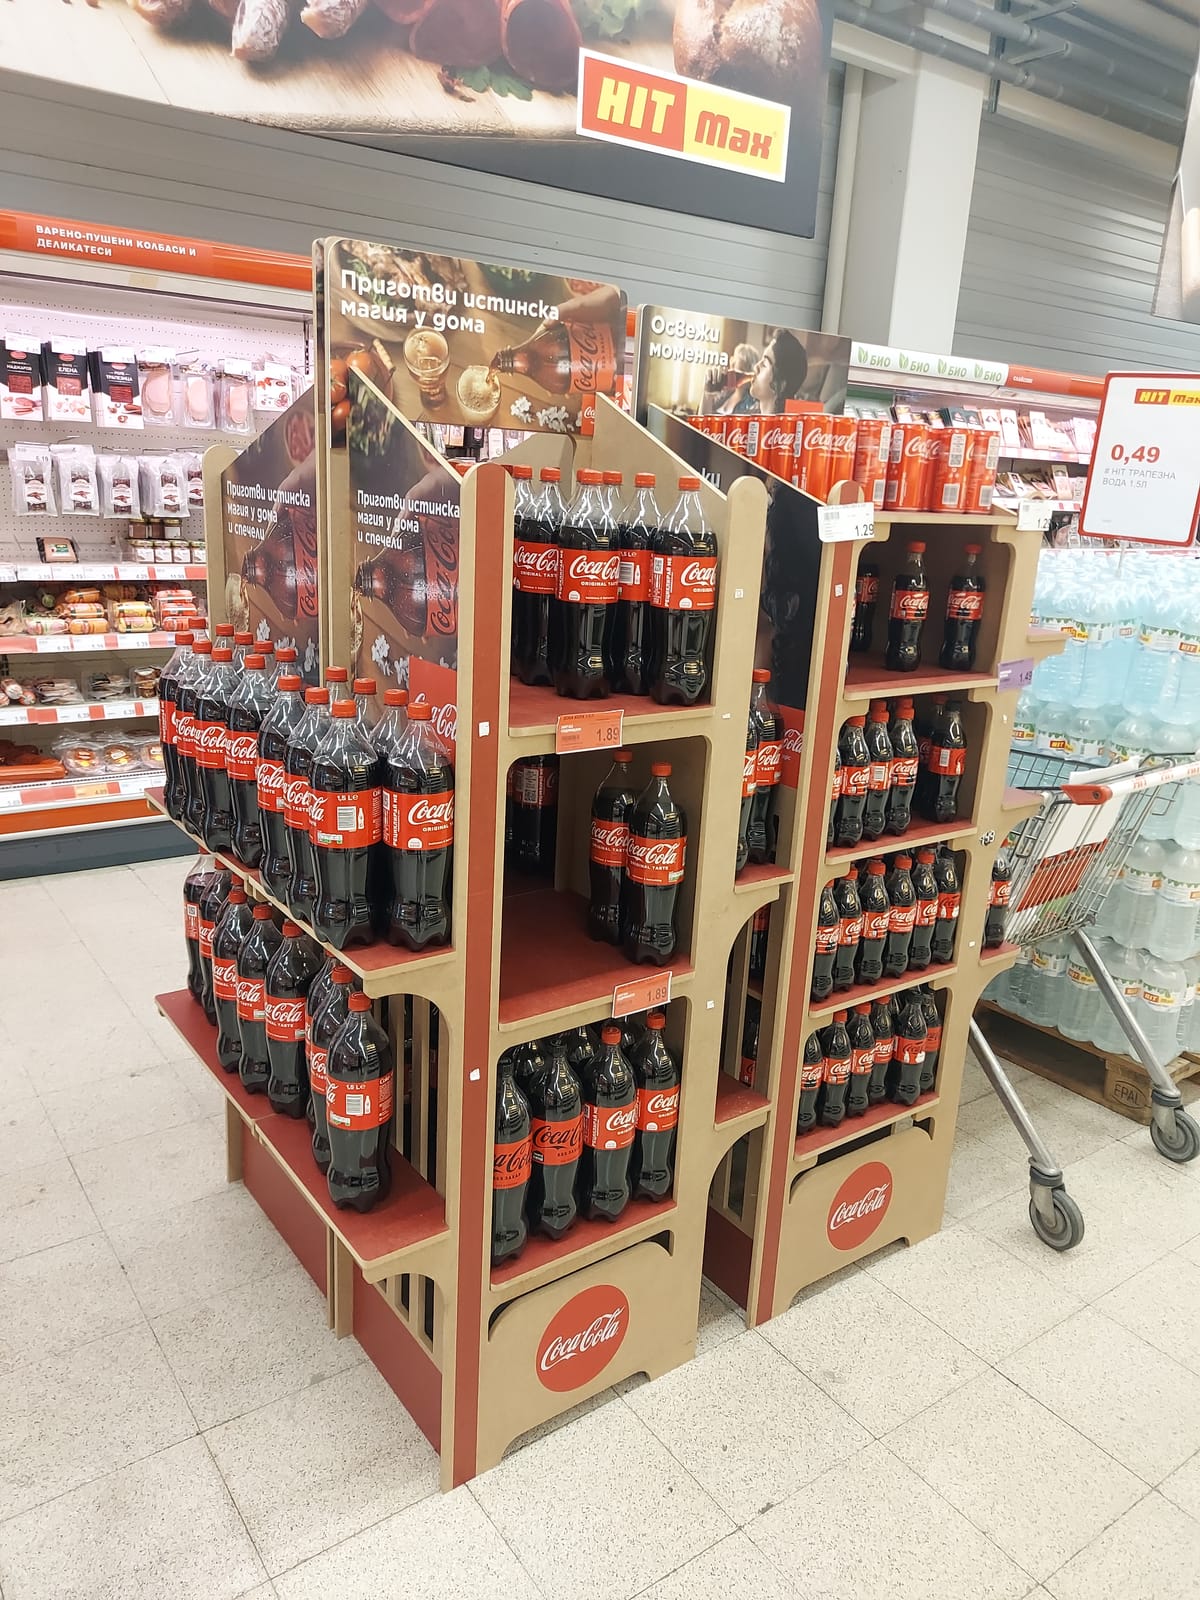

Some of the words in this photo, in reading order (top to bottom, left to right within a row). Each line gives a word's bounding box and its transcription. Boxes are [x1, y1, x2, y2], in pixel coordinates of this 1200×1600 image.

[597, 77, 675, 134] HIT
[695, 111, 772, 159] Max
[36, 225, 132, 247] ВАРЕНО-ПУШЕНИ
[136, 240, 186, 255] КОЛБАСИ
[189, 248, 196, 256] И
[37, 238, 112, 256] ДЕЛИКАТЕСИ
[341, 269, 456, 304] Приготви
[463, 292, 559, 321] истинска
[341, 301, 407, 324] магия
[414, 309, 426, 328] у
[433, 312, 485, 334] дома
[651, 315, 720, 343] Освежи
[649, 342, 729, 367] момента
[870, 355, 891, 367] БИО
[910, 361, 930, 373] БИО
[948, 366, 967, 378] БИО
[984, 370, 1002, 382] БИО
[1139, 391, 1167, 402] HIT
[1111, 444, 1160, 465] 0,49
[1103, 477, 1126, 487] ВОДА
[1129, 469, 1176, 480] ТРАПЕЗНА
[226, 480, 266, 499] Приготви
[267, 488, 310, 508] истинска
[357, 489, 405, 511] Приготви
[408, 498, 460, 518] истинска
[227, 503, 248, 518] магия
[251, 507, 256, 521] у
[257, 509, 278, 524] дома
[357, 511, 384, 526] магия
[386, 515, 392, 531] у
[394, 518, 419, 533] дома
[228, 522, 233, 532] и
[234, 523, 265, 541] спечели
[357, 532, 363, 542] и
[365, 533, 402, 549] спечели
[855, 523, 874, 537] 1.29
[596, 728, 618, 741] 1.89
[647, 987, 666, 1002] 1.89
[1114, 1083, 1140, 1106] EPAL
[830, 1183, 890, 1230] Coca-Cola
[541, 1305, 625, 1371] Coca-Cola
